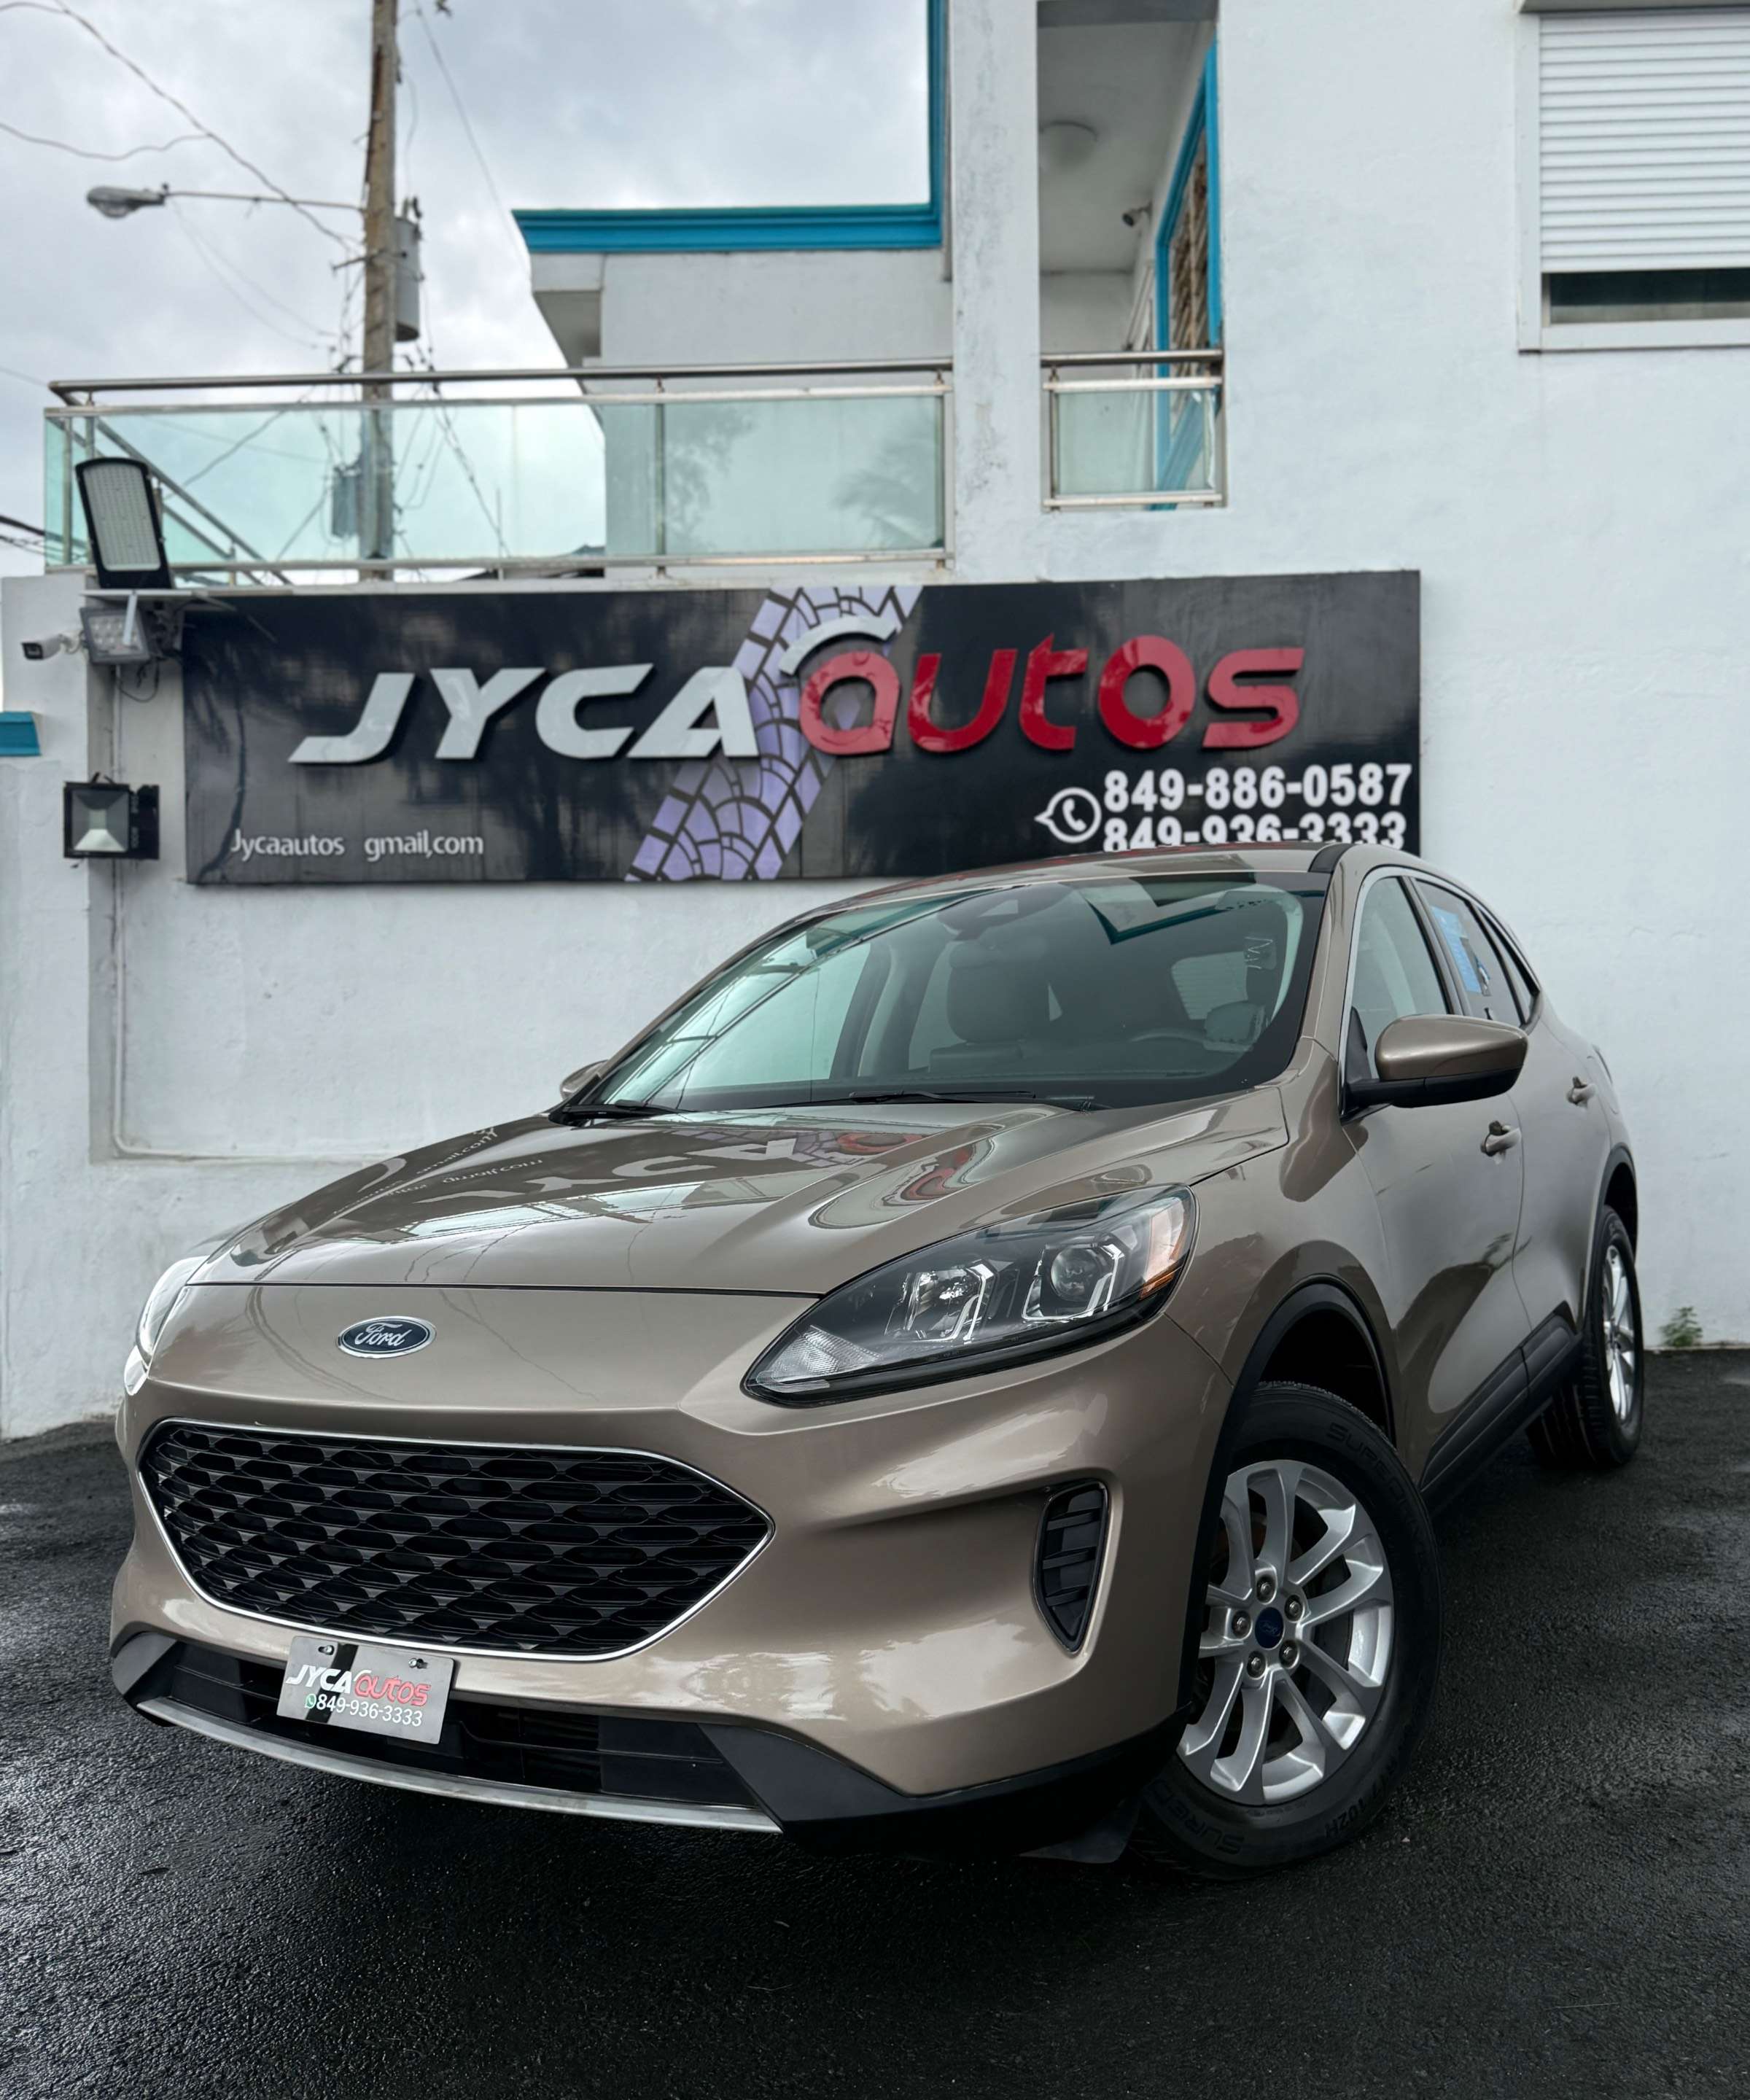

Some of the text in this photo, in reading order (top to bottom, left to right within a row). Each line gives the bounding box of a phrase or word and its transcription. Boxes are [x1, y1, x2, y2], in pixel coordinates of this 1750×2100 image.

[288, 663, 760, 763] JYCA
[1104, 763, 1412, 812] 849-886-0587
[230, 828, 346, 862] Jycaautos
[1103, 811, 1407, 852] 849-936-3333
[354, 1322, 413, 1347] Ford
[285, 1664, 353, 1694] JYCA
[315, 1693, 423, 1727] 849-936-3333
